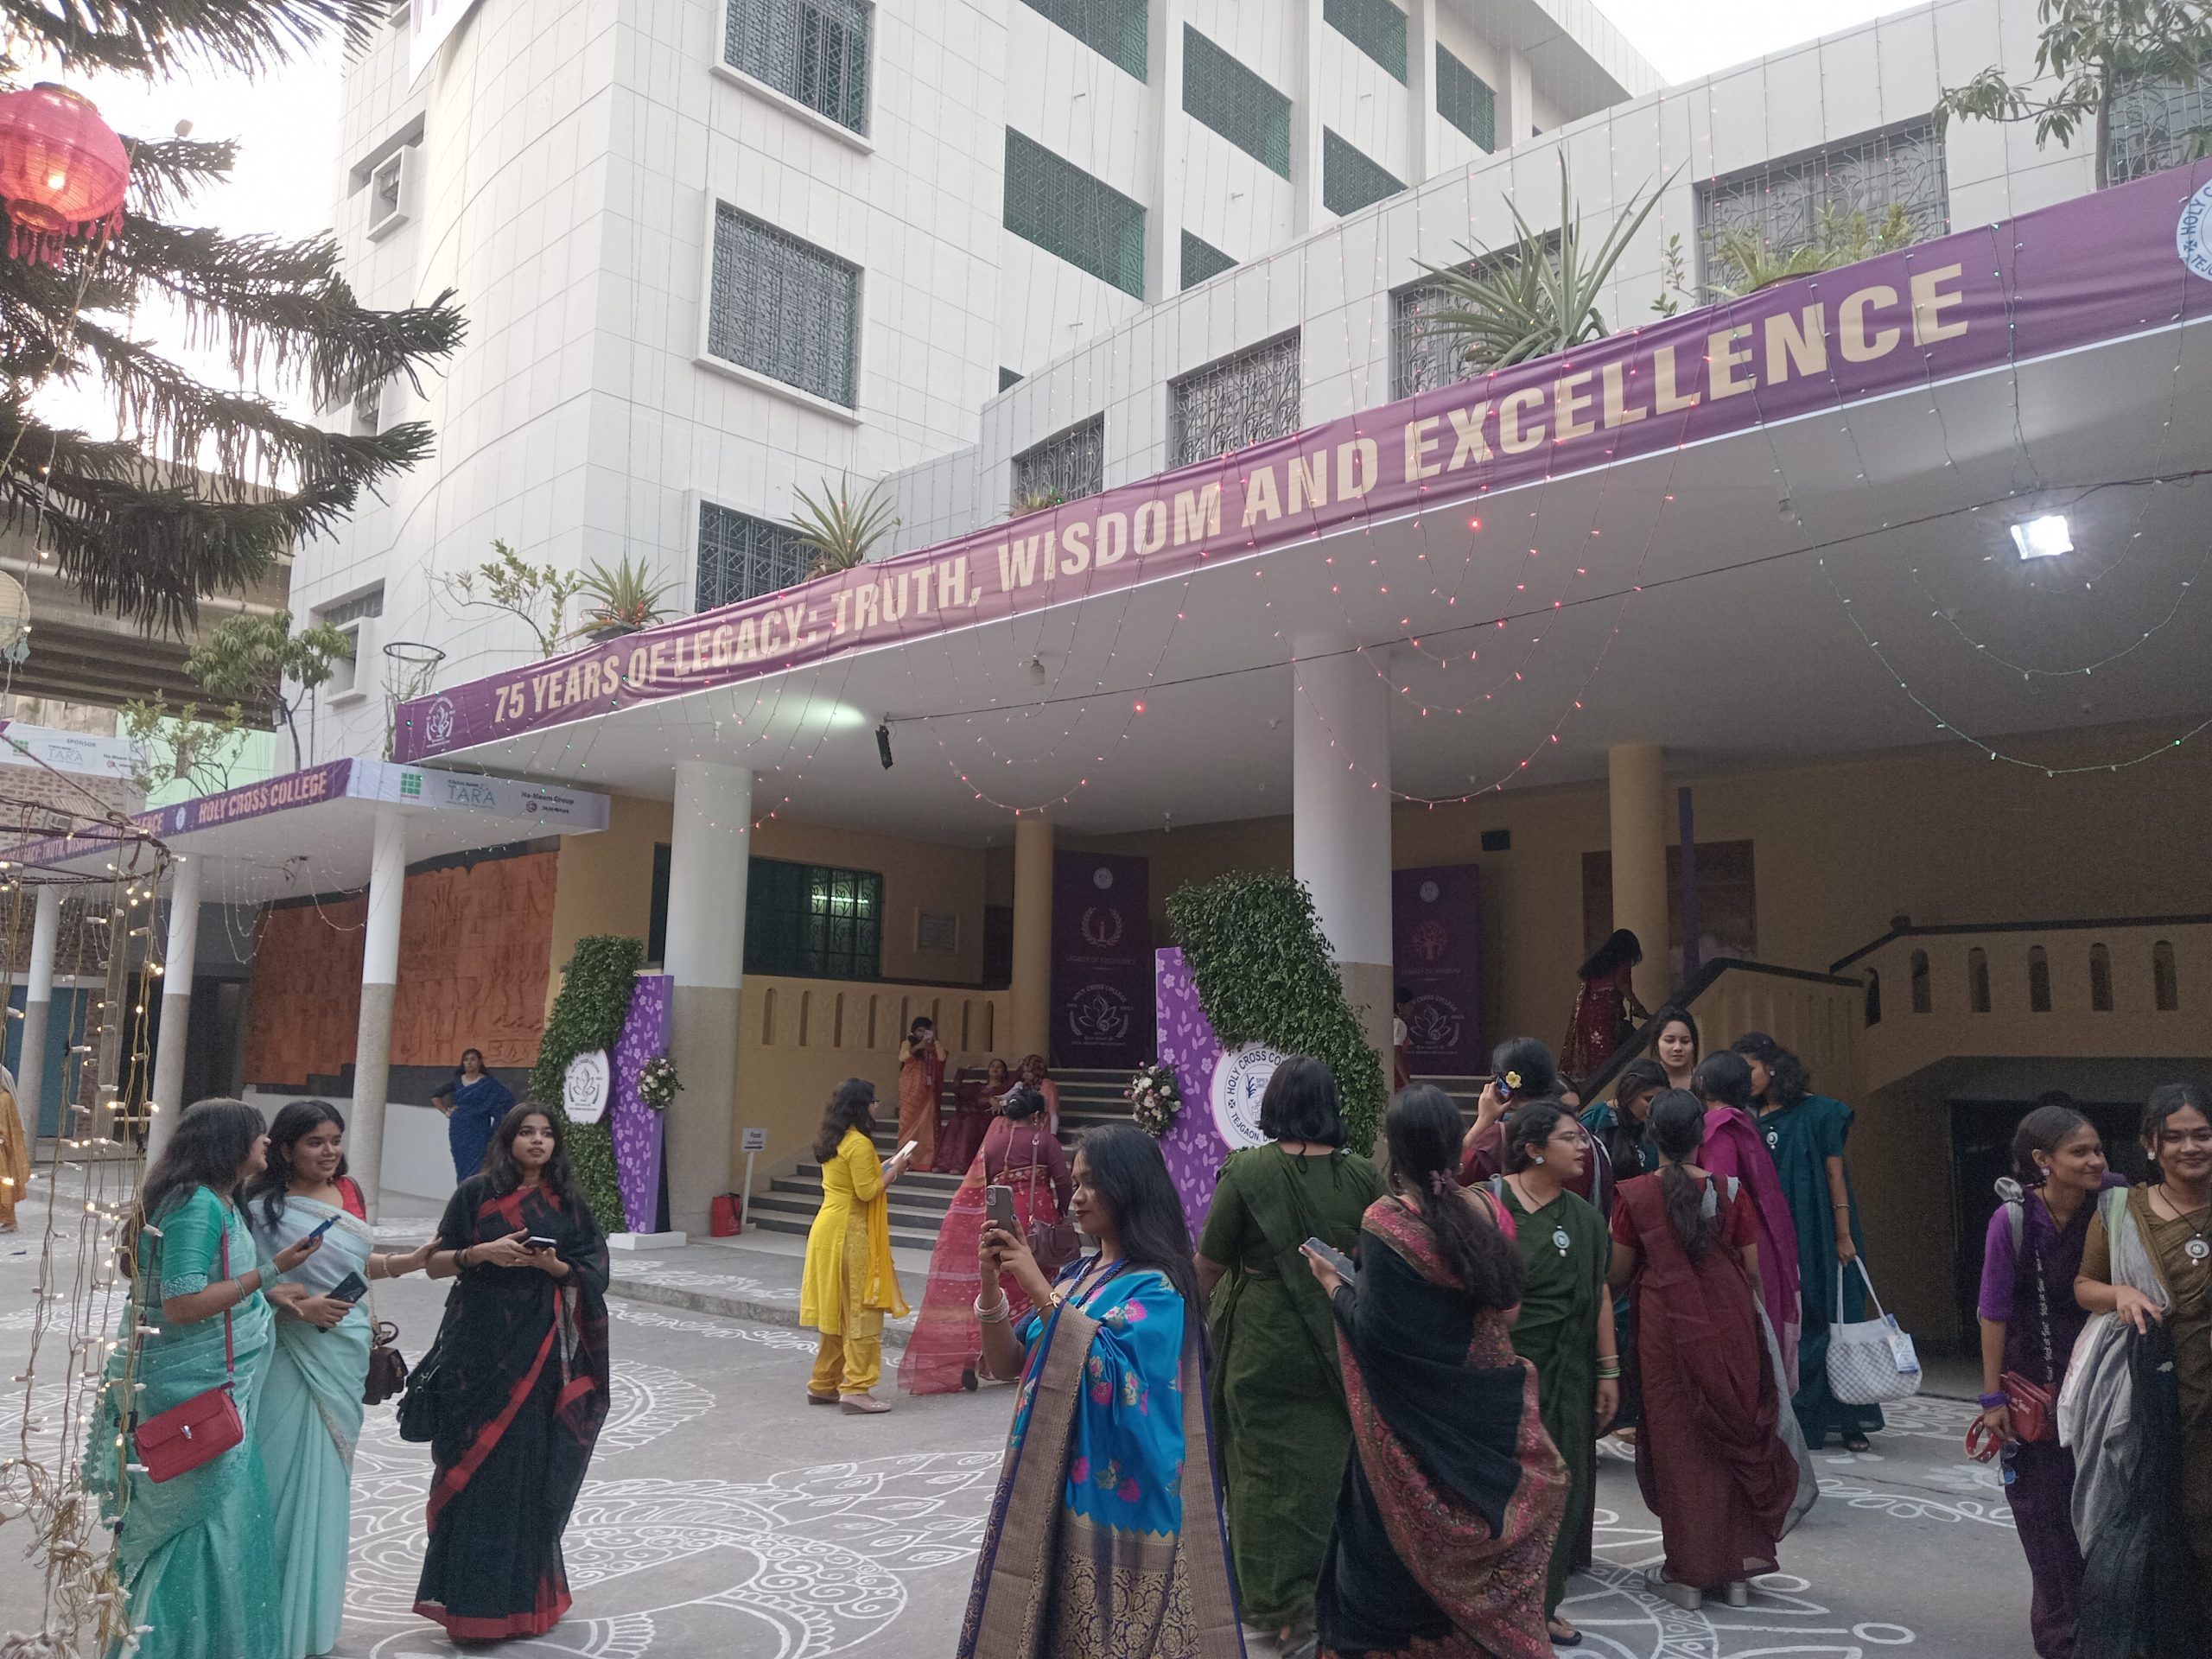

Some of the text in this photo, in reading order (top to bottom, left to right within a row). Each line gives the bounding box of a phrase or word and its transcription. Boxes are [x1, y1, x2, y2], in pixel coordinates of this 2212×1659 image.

[2180, 198, 2206, 236] HOLY
[495, 263, 1969, 723] 75 YEARS OF LEGACY: TRUTH, WISDOM AND EXCELLENCE
[67, 738, 97, 748] SPONSOR
[198, 771, 328, 824] HOLY CROSS COLLEGE
[448, 785, 496, 805] TARA
[1226, 1067, 1241, 1095] HOLY
[1238, 1051, 1267, 1070] CROSS
[1230, 1112, 1262, 1142] TEJGAON,
